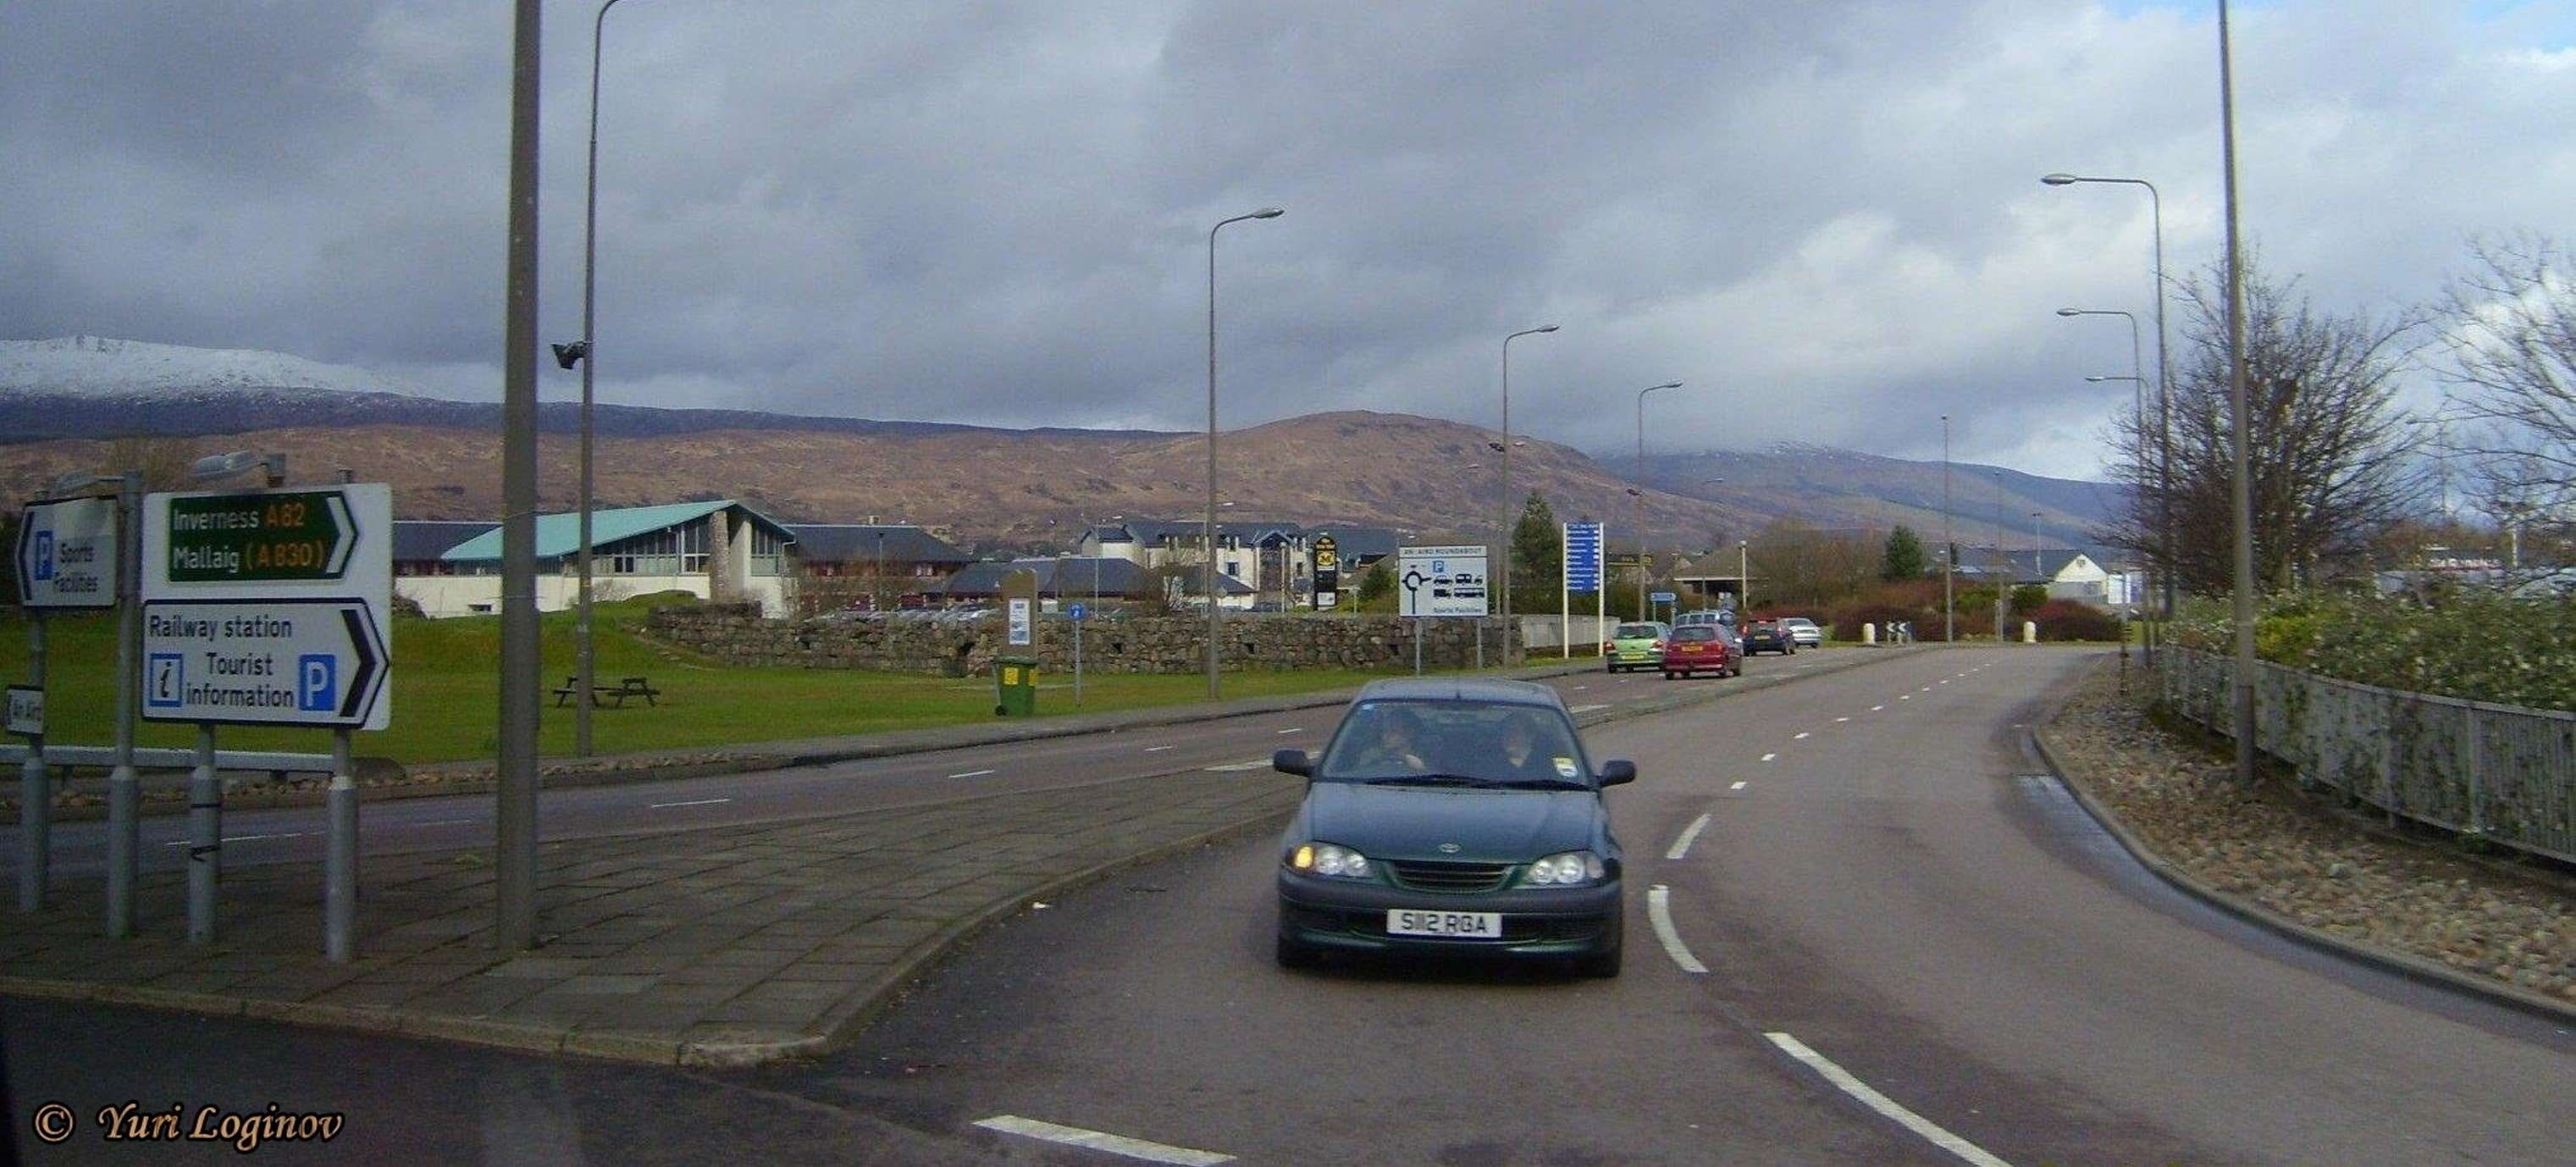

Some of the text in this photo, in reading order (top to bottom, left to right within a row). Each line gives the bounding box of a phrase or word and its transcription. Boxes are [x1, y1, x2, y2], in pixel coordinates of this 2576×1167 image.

[174, 503, 306, 530] Inverness A82
[59, 542, 95, 565] Sports
[174, 539, 324, 573] Mallaig (A830)
[53, 570, 99, 593] Facilities
[149, 614, 293, 641] Railway station
[206, 652, 274, 676] Tourist
[186, 683, 294, 707] information
[306, 661, 329, 707] P
[1446, 914, 1489, 934] RGA
